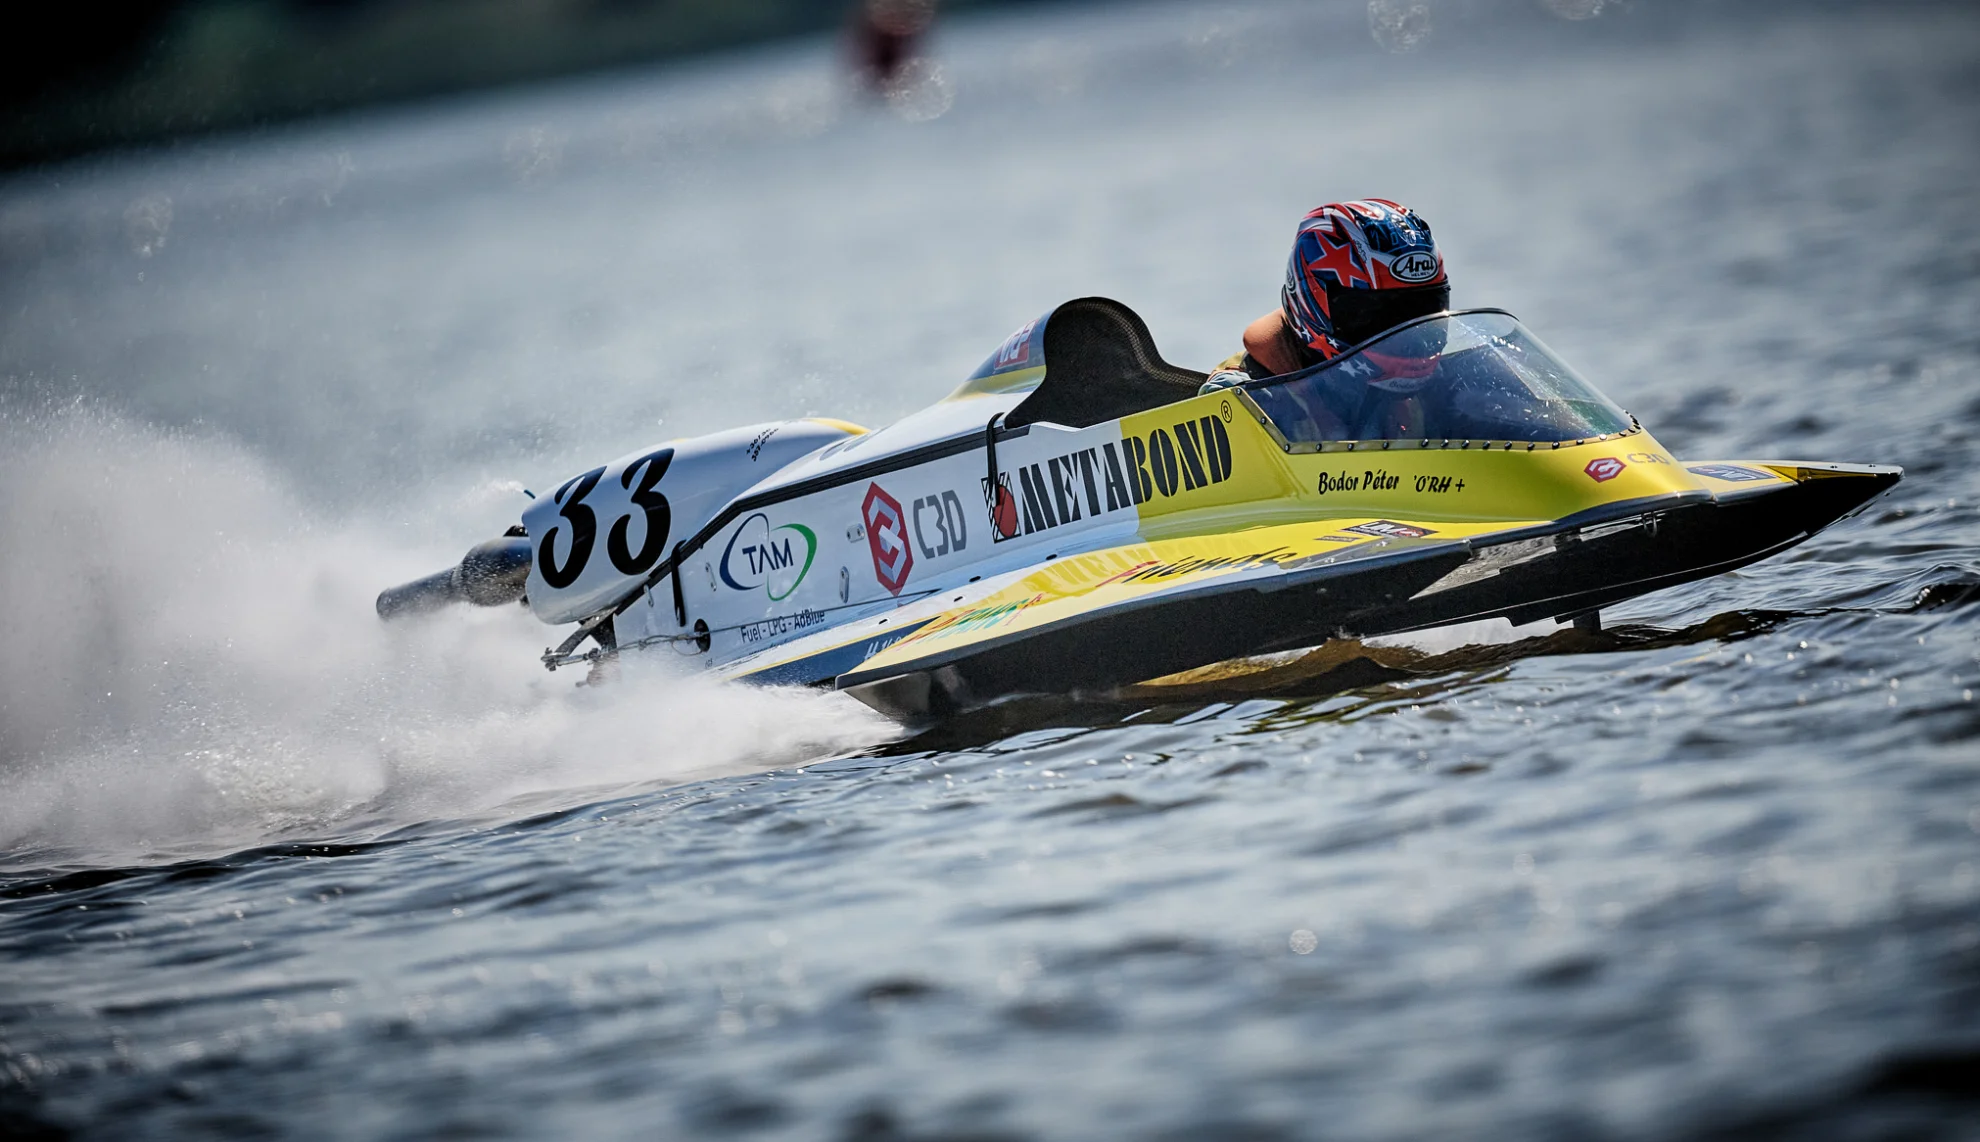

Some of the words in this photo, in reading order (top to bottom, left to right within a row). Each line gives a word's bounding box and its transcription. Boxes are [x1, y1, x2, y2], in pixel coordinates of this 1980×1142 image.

[1395, 255, 1434, 274] Arai
[1318, 470, 1359, 495] Bodor
[1362, 469, 1400, 491] Péter
[538, 447, 675, 589] 33
[912, 490, 968, 560] C3D
[741, 537, 794, 576] TAM
[740, 622, 763, 643] Fuel
[768, 616, 787, 636] LPG
[794, 608, 825, 630] AdBlue
